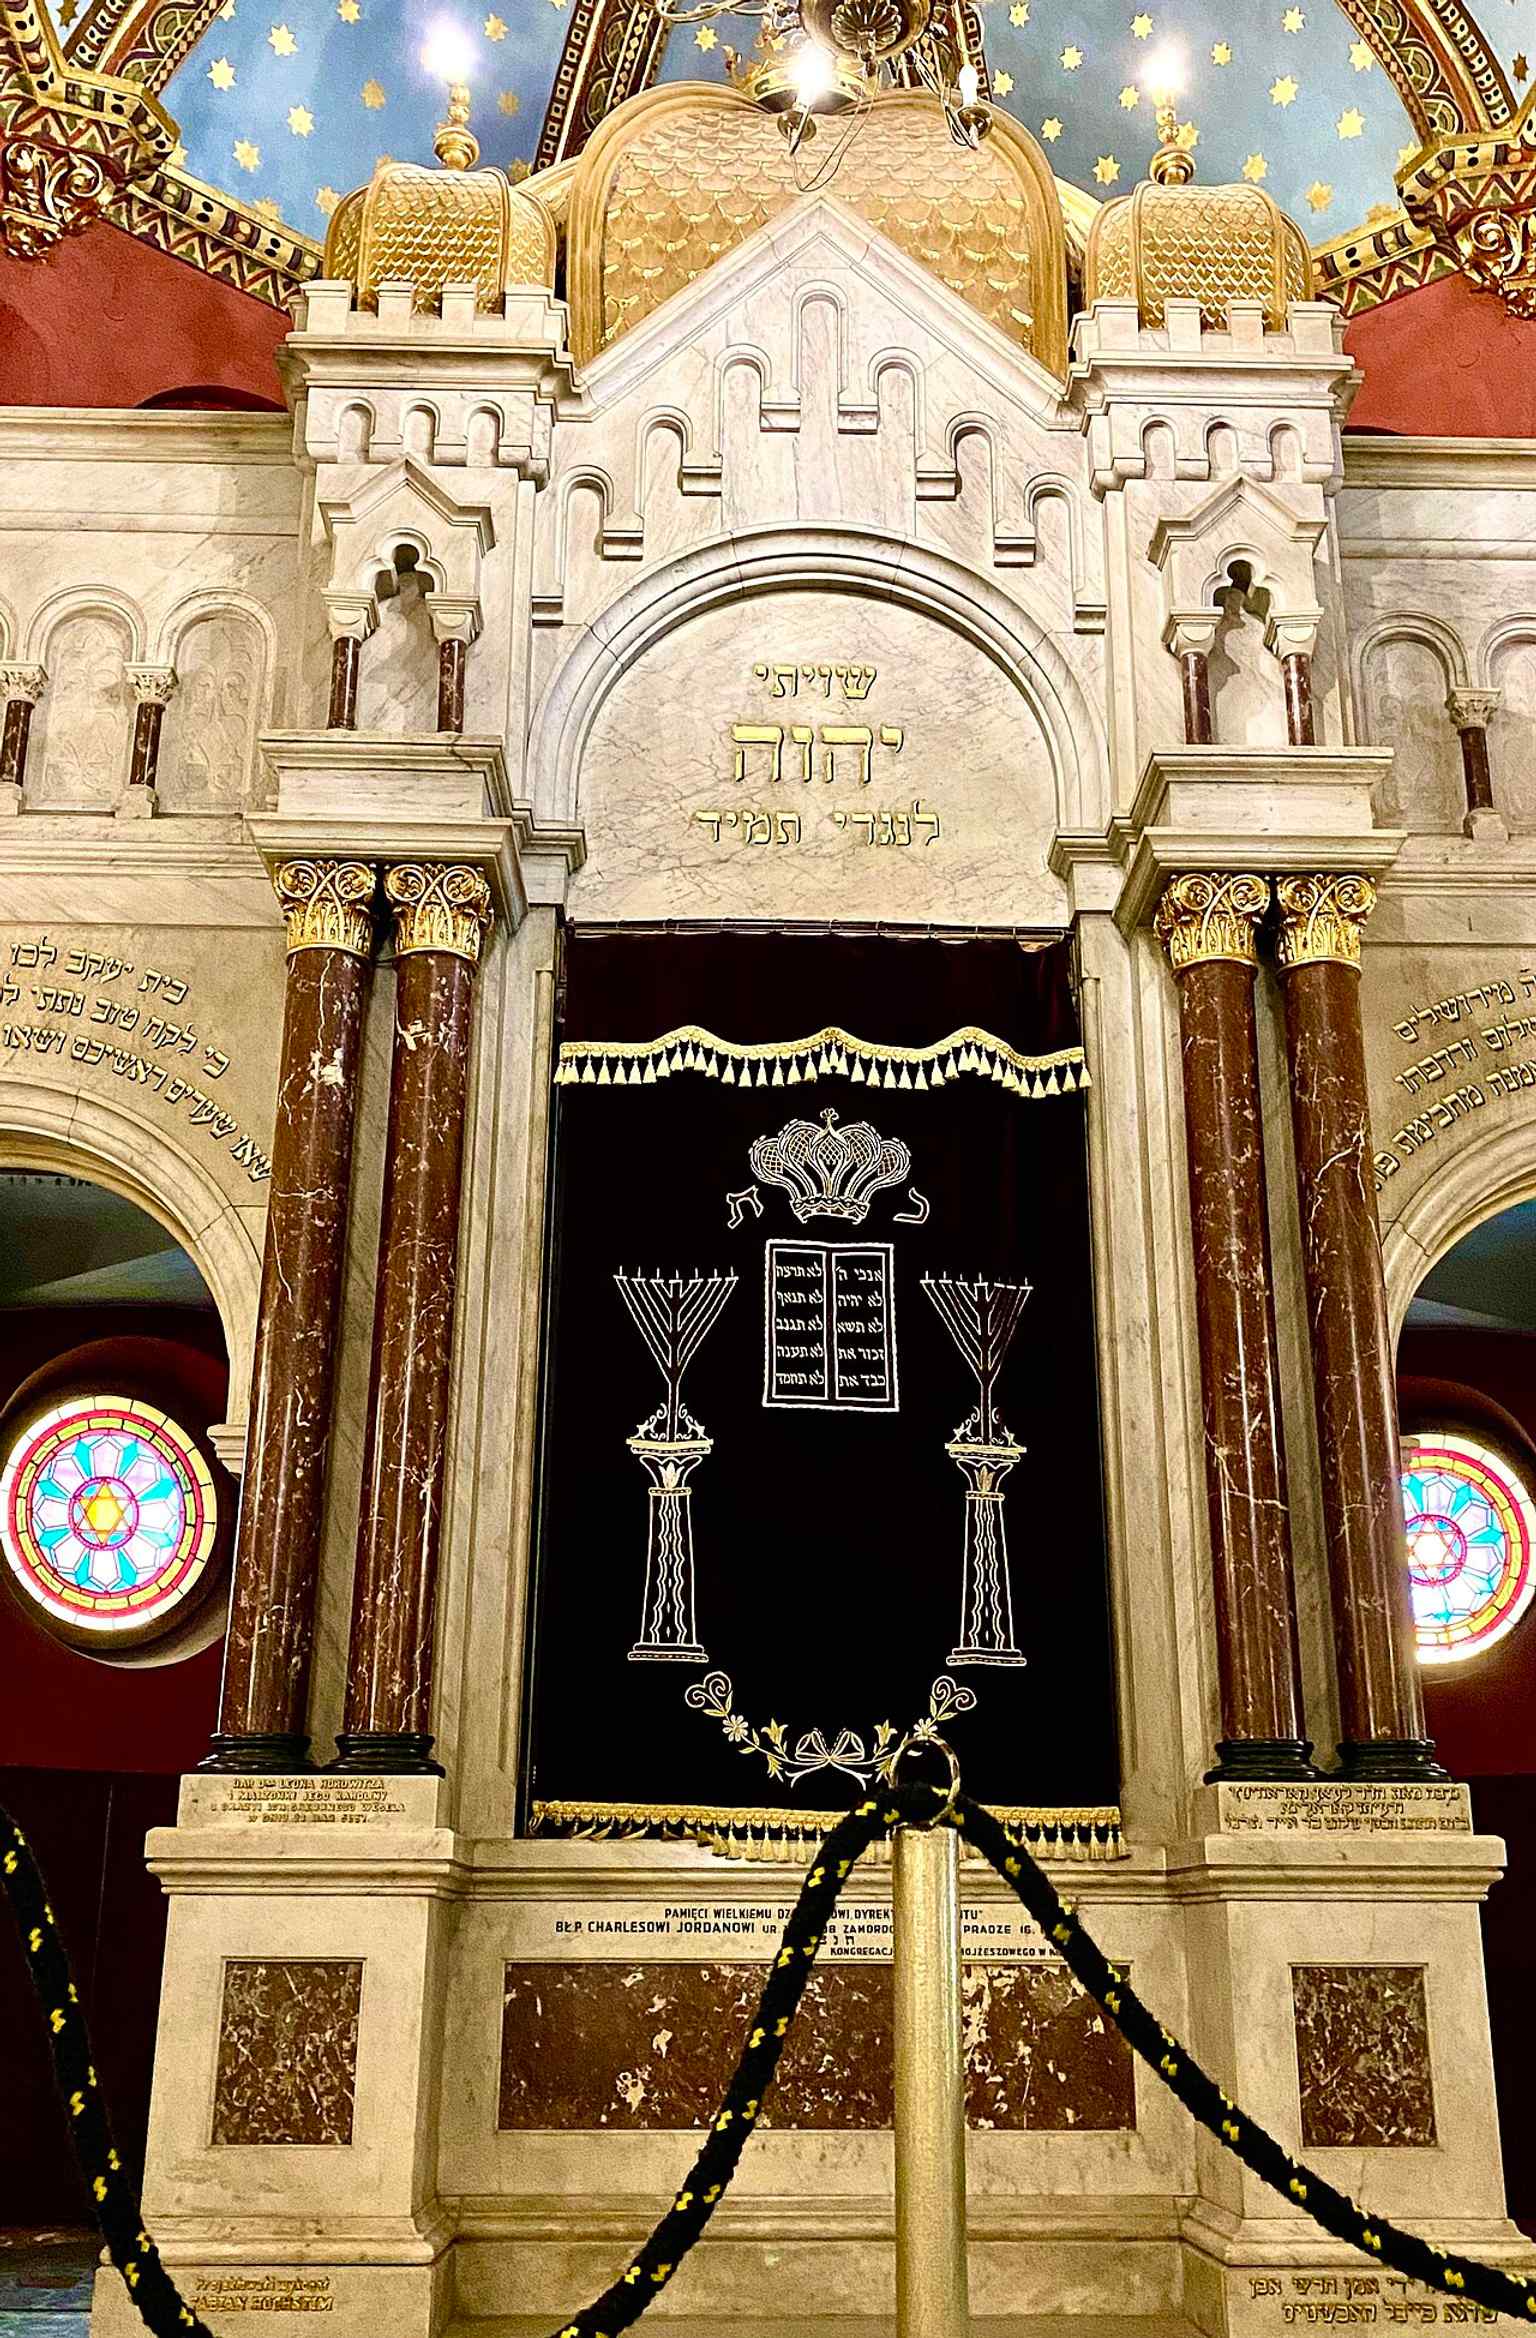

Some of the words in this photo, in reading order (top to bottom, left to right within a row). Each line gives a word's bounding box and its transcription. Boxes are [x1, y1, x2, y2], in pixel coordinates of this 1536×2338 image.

[753, 664, 877, 699] שויתי
[730, 724, 904, 782] יהוה
[695, 810, 801, 844] תמיד
[832, 800, 940, 846] לנגדי
[11, 935, 57, 968] לכו
[65, 947, 134, 983] יעקב
[138, 967, 188, 1004] בית
[31, 985, 85, 1016] נתתי
[90, 998, 139, 1031] טוב
[1392, 980, 1516, 1043] מירושלים
[3, 1023, 67, 1054] ושאו
[143, 1017, 197, 1054] לקח
[203, 1045, 230, 1079] כי
[164, 1077, 237, 1139] שערים
[806, 1261, 822, 1277] לא
[854, 1268, 883, 1281] אנכי
[777, 1291, 806, 1307] תנאף
[808, 1288, 824, 1304] לא
[838, 1294, 863, 1307] יהיה
[868, 1290, 883, 1307] לא
[776, 1318, 806, 1331] תגנב
[808, 1314, 823, 1331] לא
[837, 1321, 865, 1333] תשא
[868, 1316, 883, 1333] לא
[777, 1345, 808, 1358] תענה
[810, 1342, 824, 1358] לא
[838, 1347, 857, 1360] את
[858, 1348, 884, 1360] זכור
[809, 1369, 824, 1386] לא
[839, 1375, 859, 1387] את
[860, 1374, 885, 1386] כבד
[664, 1908, 708, 1920] PAMIĘCI
[713, 1909, 772, 1919] WIELKIEMU
[588, 1921, 670, 1933] CHARLESOWI
[676, 1922, 755, 1933] JORDANOWI
[843, 1925, 894, 1934] ZAMORDO
[963, 1925, 1012, 1934] PRADZE
[830, 1947, 893, 1956] KONGREGACJ
